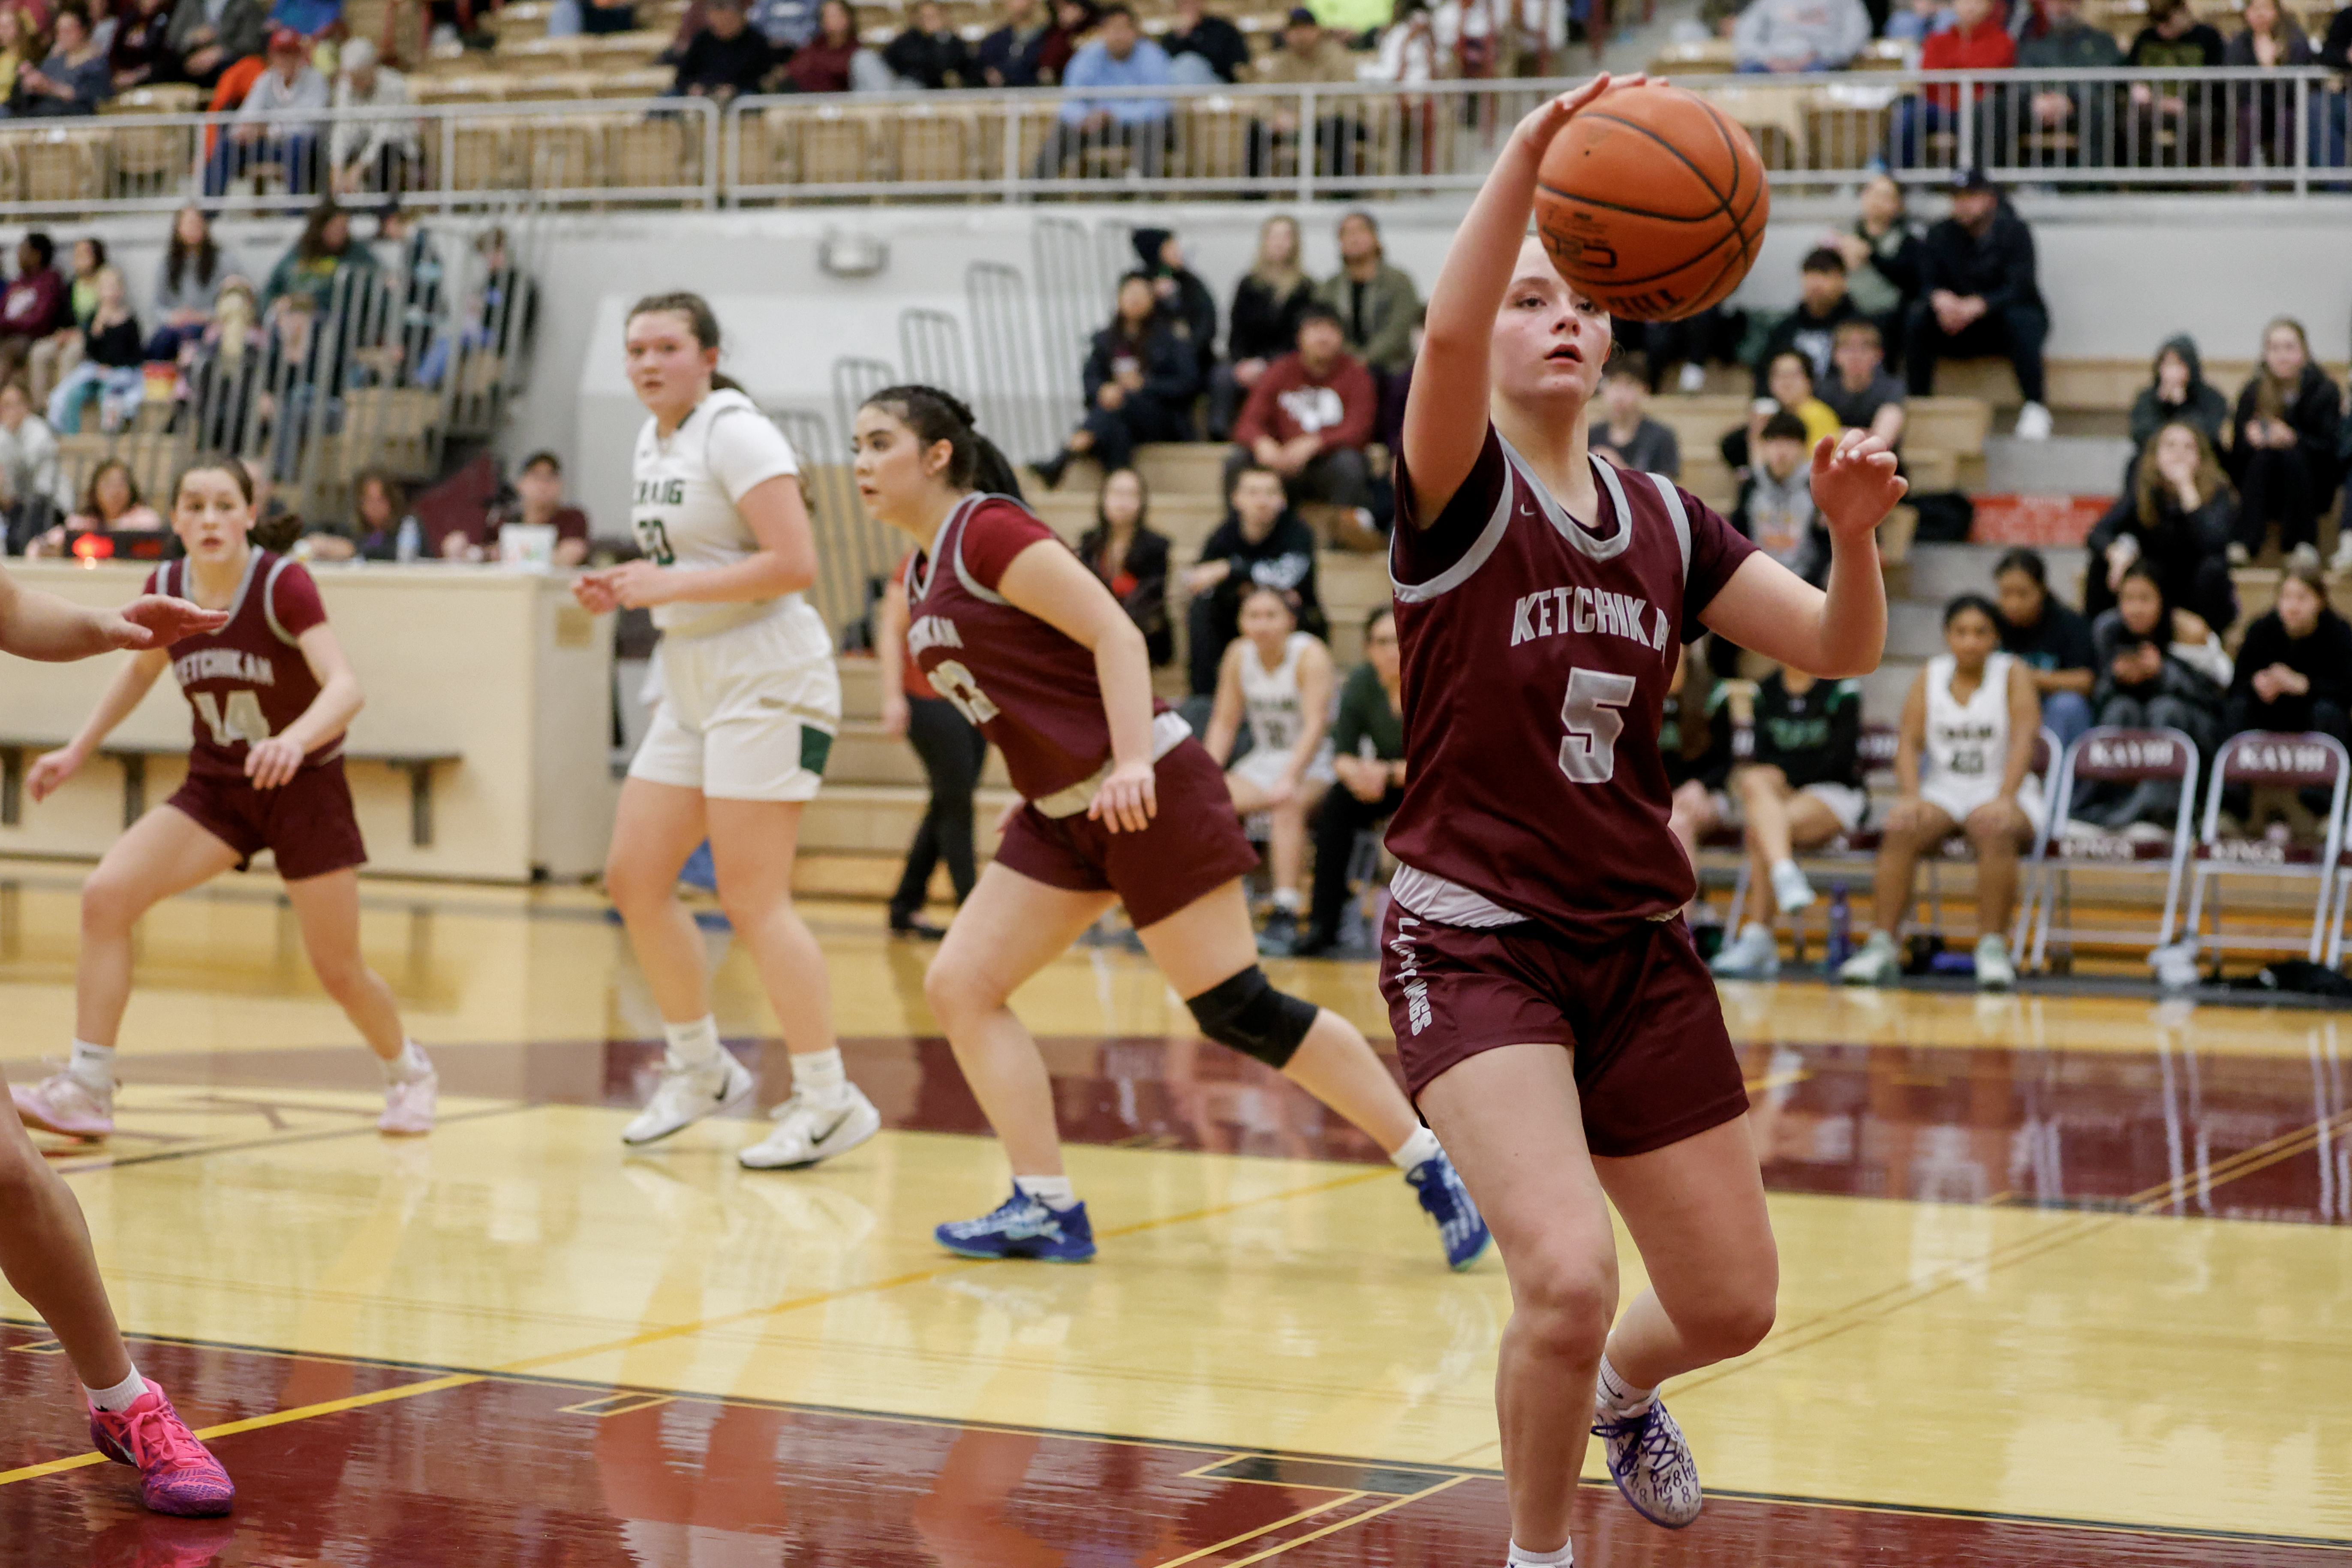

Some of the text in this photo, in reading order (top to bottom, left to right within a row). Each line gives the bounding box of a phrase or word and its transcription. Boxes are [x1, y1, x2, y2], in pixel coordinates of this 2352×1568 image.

[1510, 585, 1671, 653] KETCHIKA
[1558, 666, 1636, 783] 5
[1673, 1469, 1682, 1488] 8
[1681, 1486, 1691, 1504] 8
